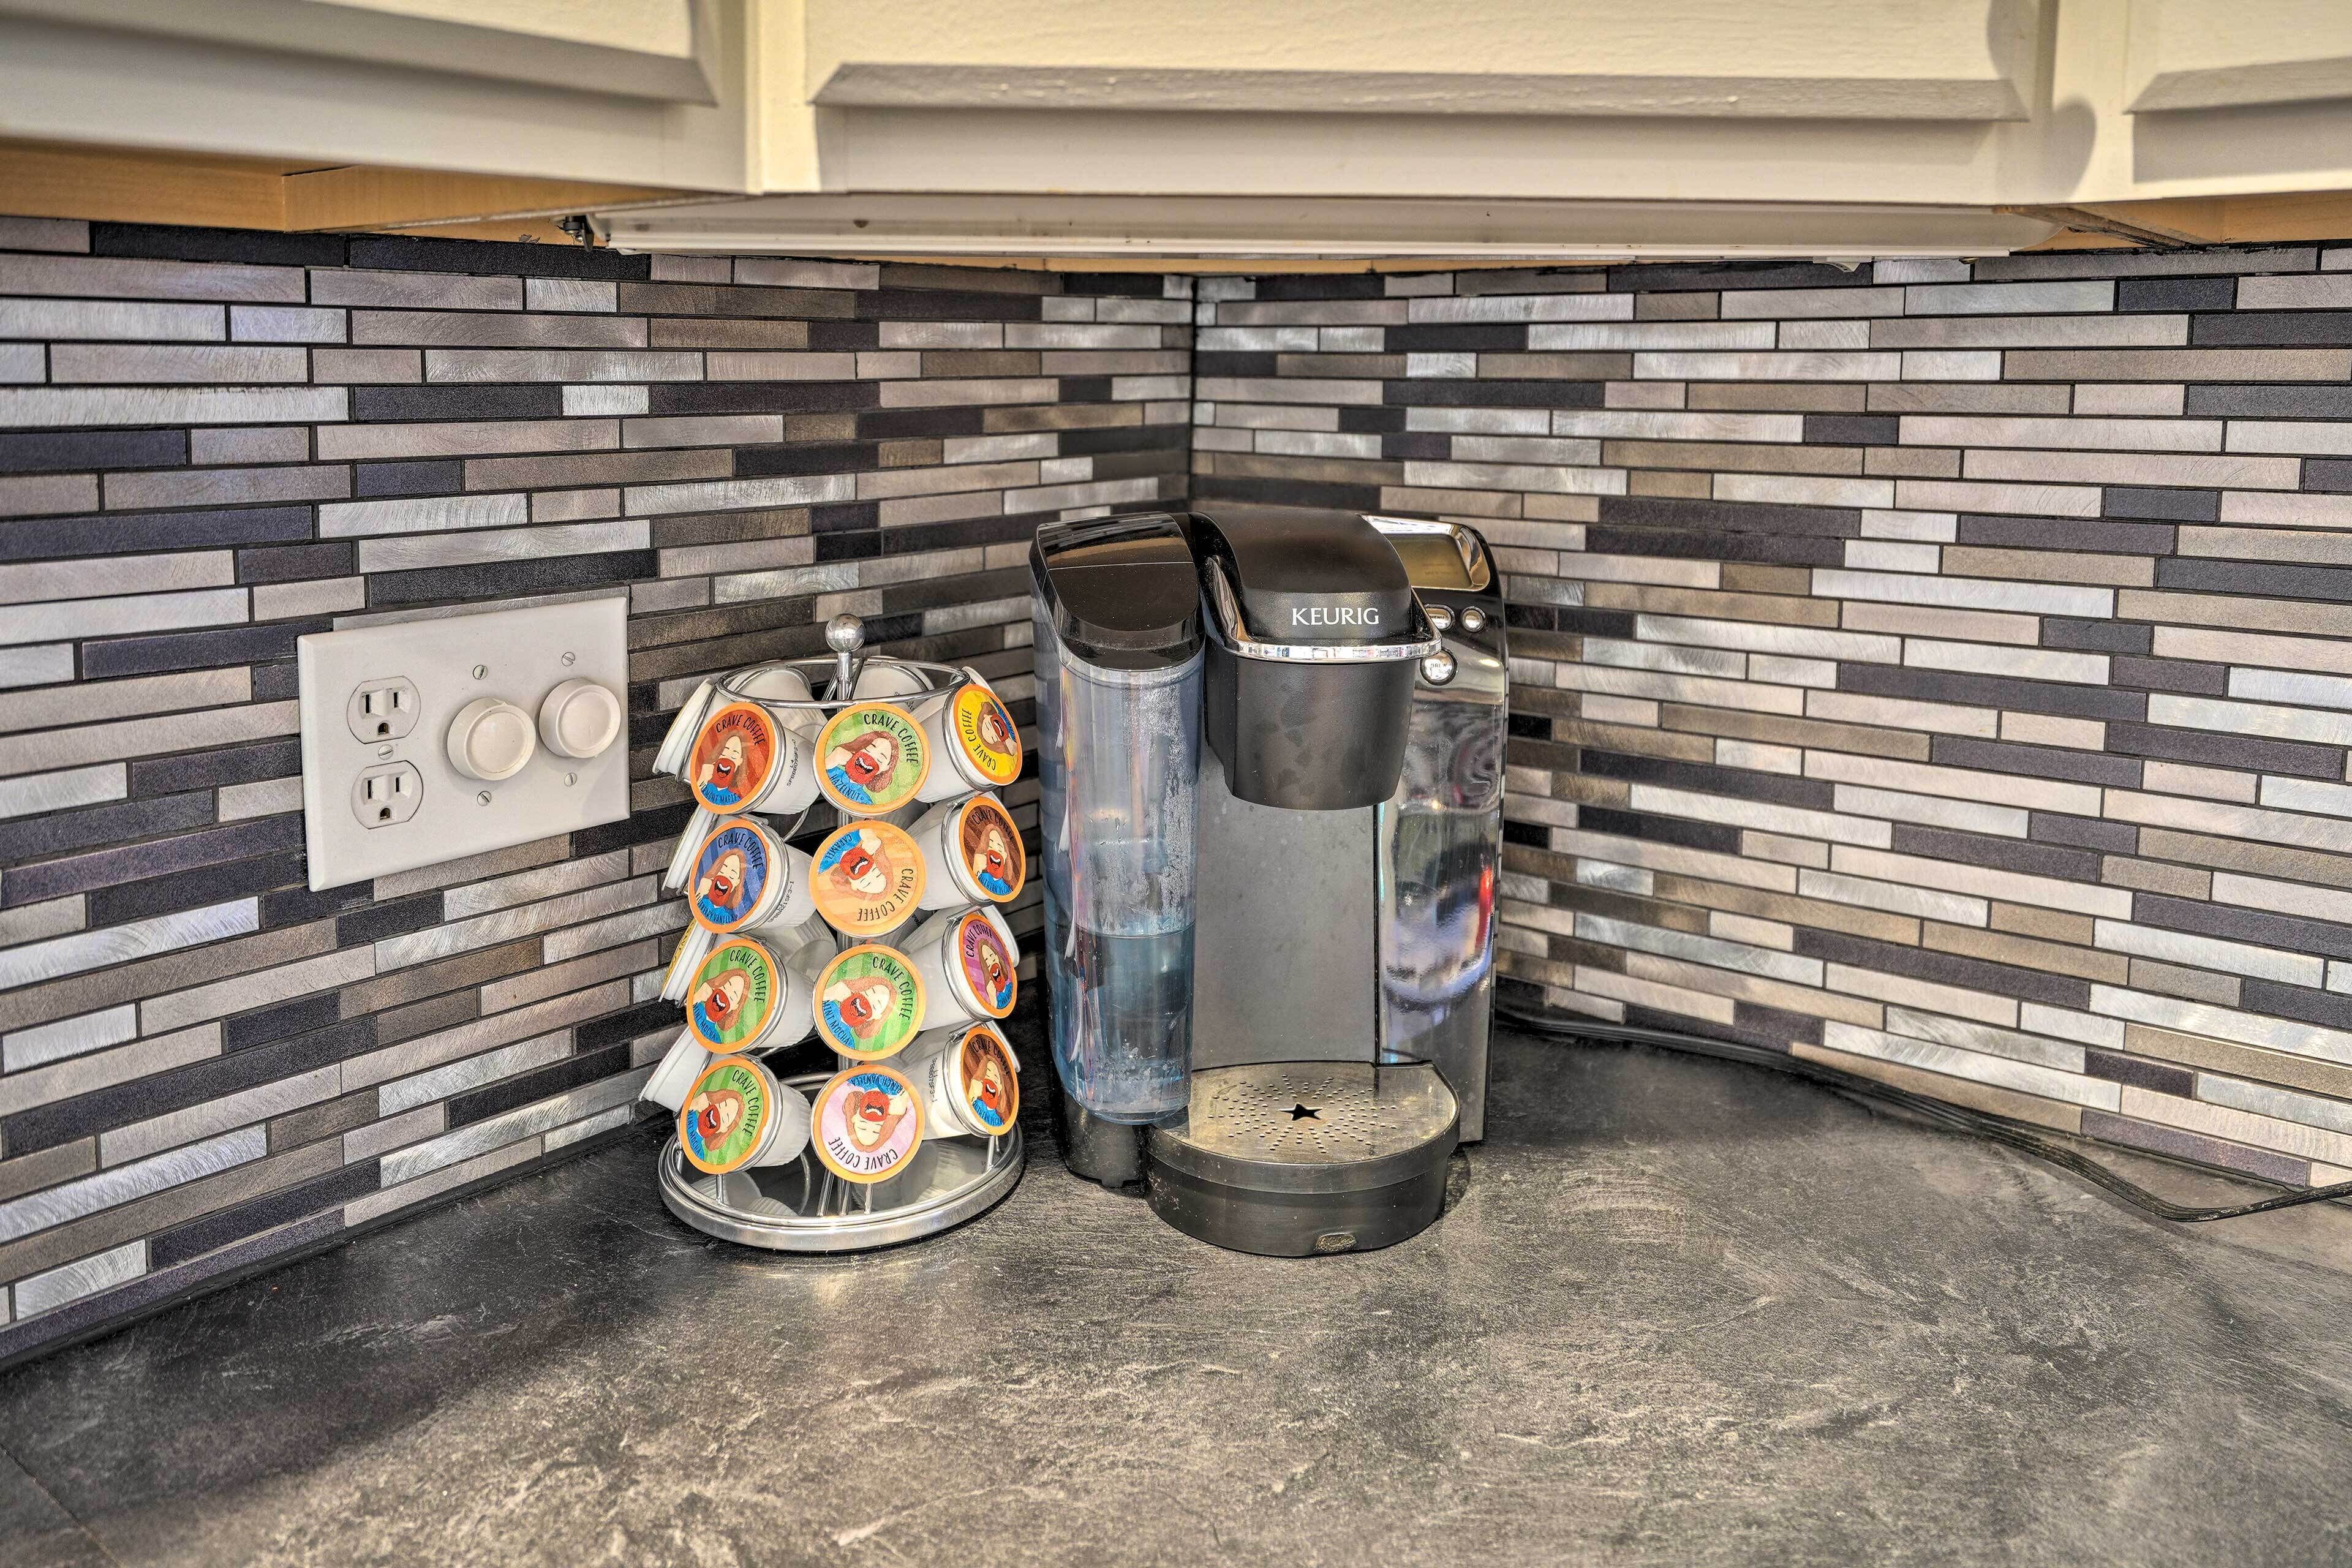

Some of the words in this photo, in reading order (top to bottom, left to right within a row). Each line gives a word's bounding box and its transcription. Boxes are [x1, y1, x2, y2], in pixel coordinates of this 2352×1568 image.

[1292, 608, 1379, 625] KEURIG
[715, 714, 743, 733] CRAVE
[743, 717, 765, 746] COFFEE
[962, 708, 976, 742] COFFEE
[864, 714, 899, 731] CRAVE
[897, 728, 919, 764] COFFEE
[973, 745, 996, 771] CRAVE
[699, 782, 718, 804] VERMONT
[719, 793, 739, 804] MAPLE
[829, 774, 861, 801] HAZELNUT
[971, 809, 993, 824] CRAVE
[718, 832, 745, 848] CRAVE
[744, 837, 764, 870] COFFEE
[827, 833, 852, 860] CARAMEL
[893, 868, 914, 903] CRAVE
[857, 901, 895, 921] COFFEE
[966, 929, 978, 957] CRAVE
[973, 924, 993, 939] COFFEE
[729, 949, 758, 969] CRAVE
[752, 966, 766, 1003] COFFEE
[872, 956, 904, 981] CRAVE
[898, 981, 913, 1020] COFFEE
[693, 1004, 702, 1023] MINT
[699, 1020, 717, 1041] MOCHA
[822, 1000, 832, 1020] MINT
[829, 1019, 850, 1044] MOCHA
[971, 1039, 992, 1053] CRAVE
[731, 1070, 756, 1096] CRAVE
[851, 1075, 877, 1086] VANILLA
[882, 1076, 905, 1096] FRENCH
[742, 1097, 760, 1137] COFFEE
[688, 1129, 701, 1155] MOCHA
[828, 1136, 861, 1168] COFFEE
[864, 1148, 898, 1170] CRAVE
